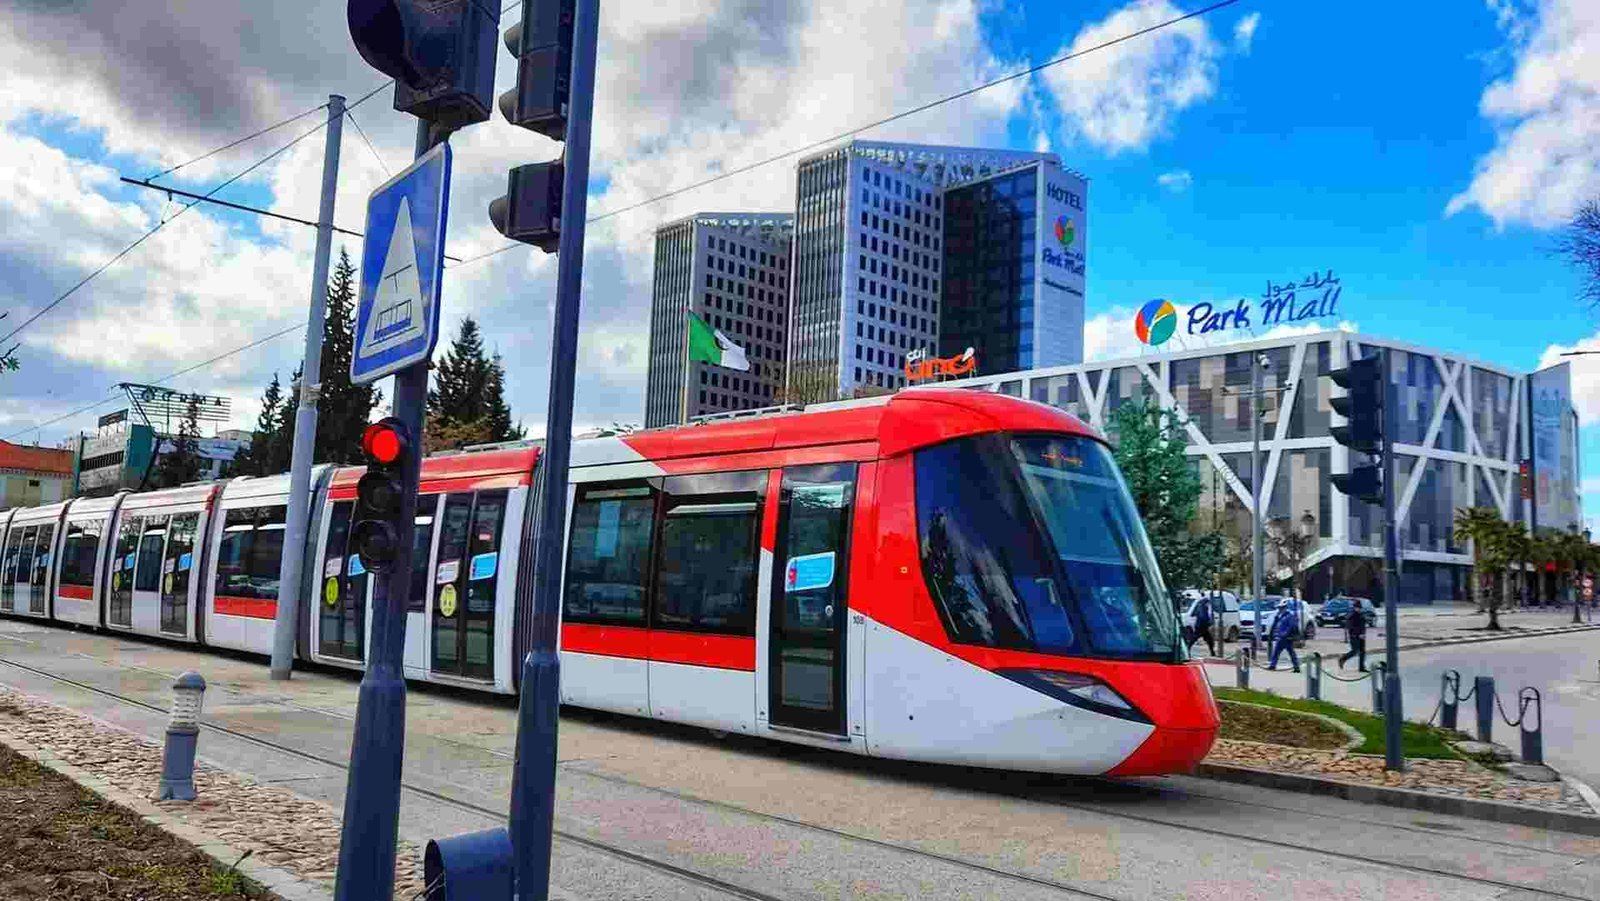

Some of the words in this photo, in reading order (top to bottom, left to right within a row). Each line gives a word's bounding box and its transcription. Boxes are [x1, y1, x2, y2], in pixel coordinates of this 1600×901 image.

[1047, 182, 1082, 211] HOTEL
[1187, 298, 1250, 335] Park
[1260, 286, 1342, 325] Mall
